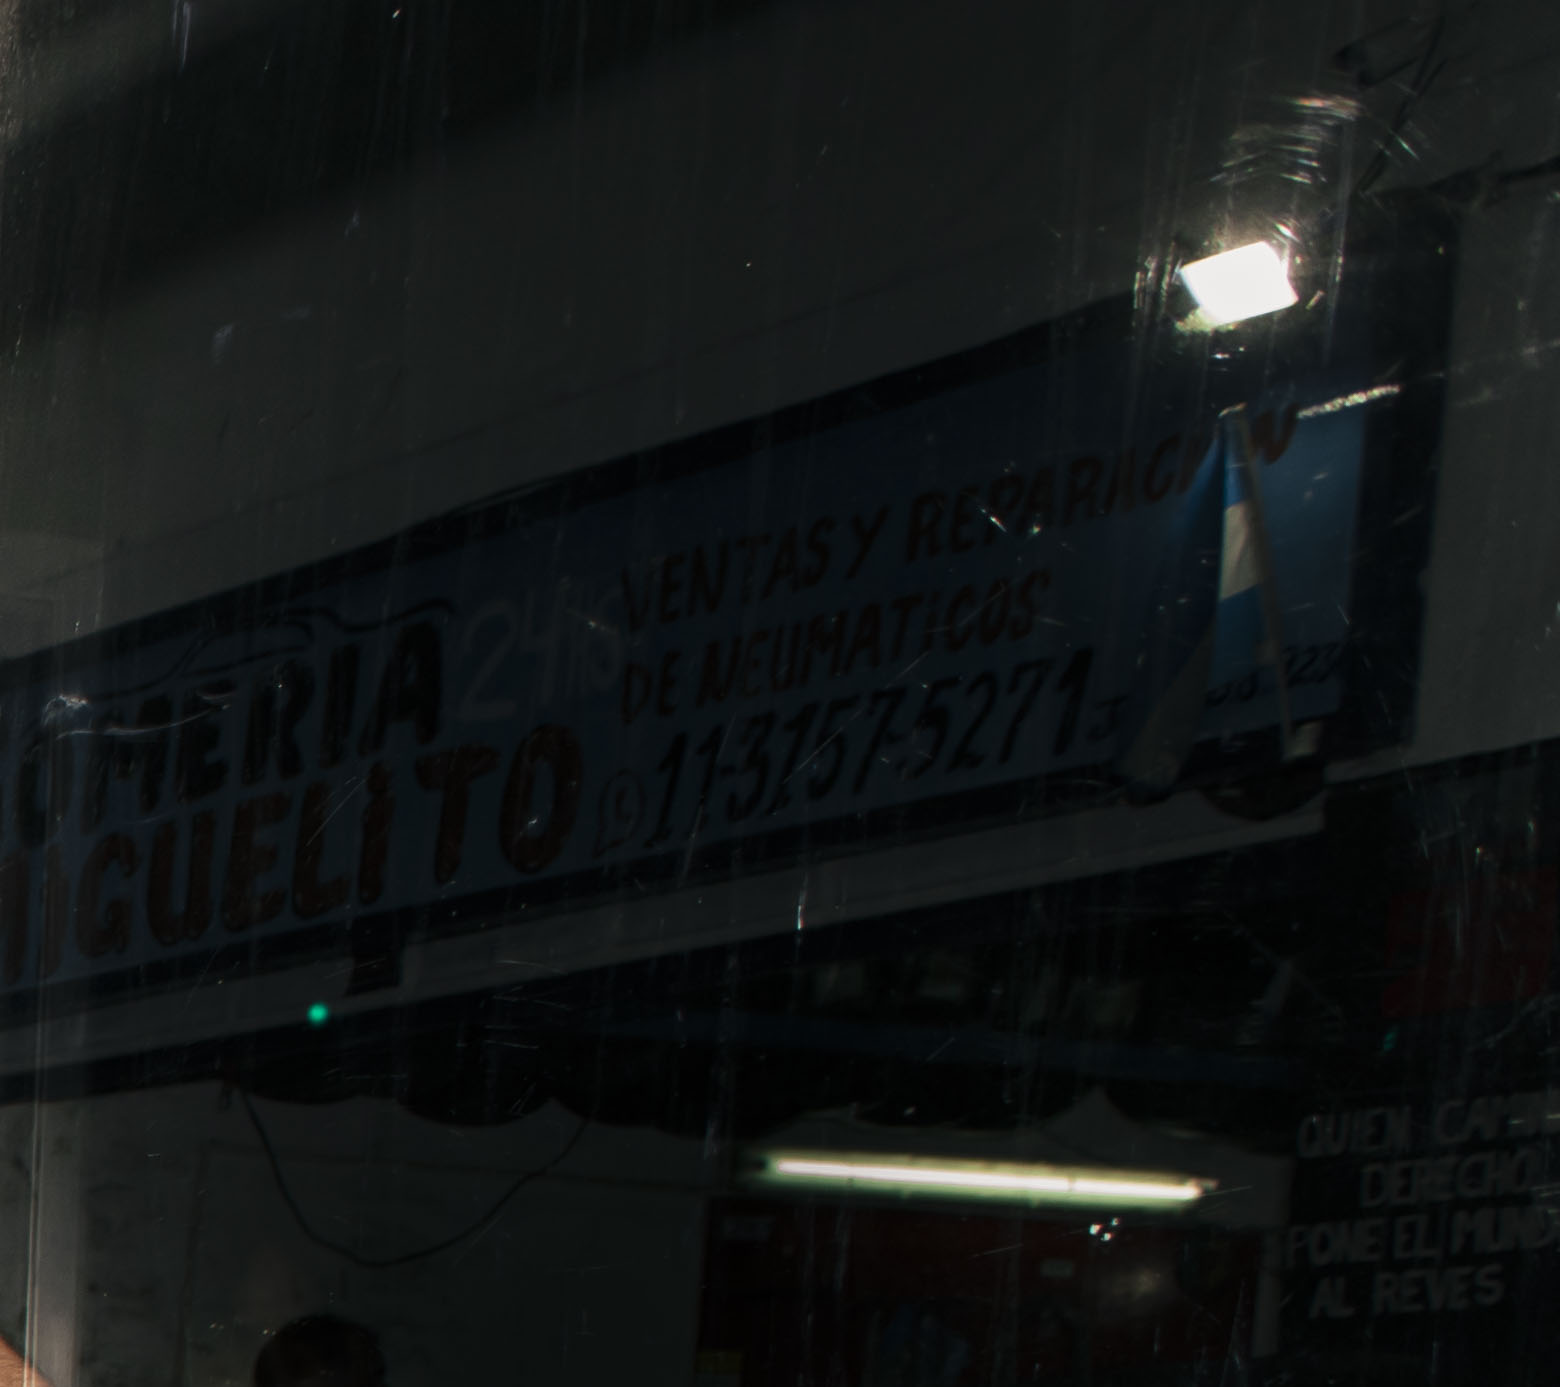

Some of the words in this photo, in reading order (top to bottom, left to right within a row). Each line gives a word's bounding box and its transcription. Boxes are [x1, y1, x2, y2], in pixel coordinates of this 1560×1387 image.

[622, 520, 831, 631] VENTAS
[845, 506, 889, 579] Y
[622, 649, 676, 723] DE
[697, 569, 1051, 704] NEUMATICOS
[1296, 1104, 1411, 1158] QUIEN
[1360, 1146, 1541, 1209] DERECHO
[1287, 1216, 1383, 1269] PONE
[1392, 1211, 1443, 1261] EL
[1307, 1275, 1357, 1320] AL
[1371, 1262, 1506, 1317] REVES
